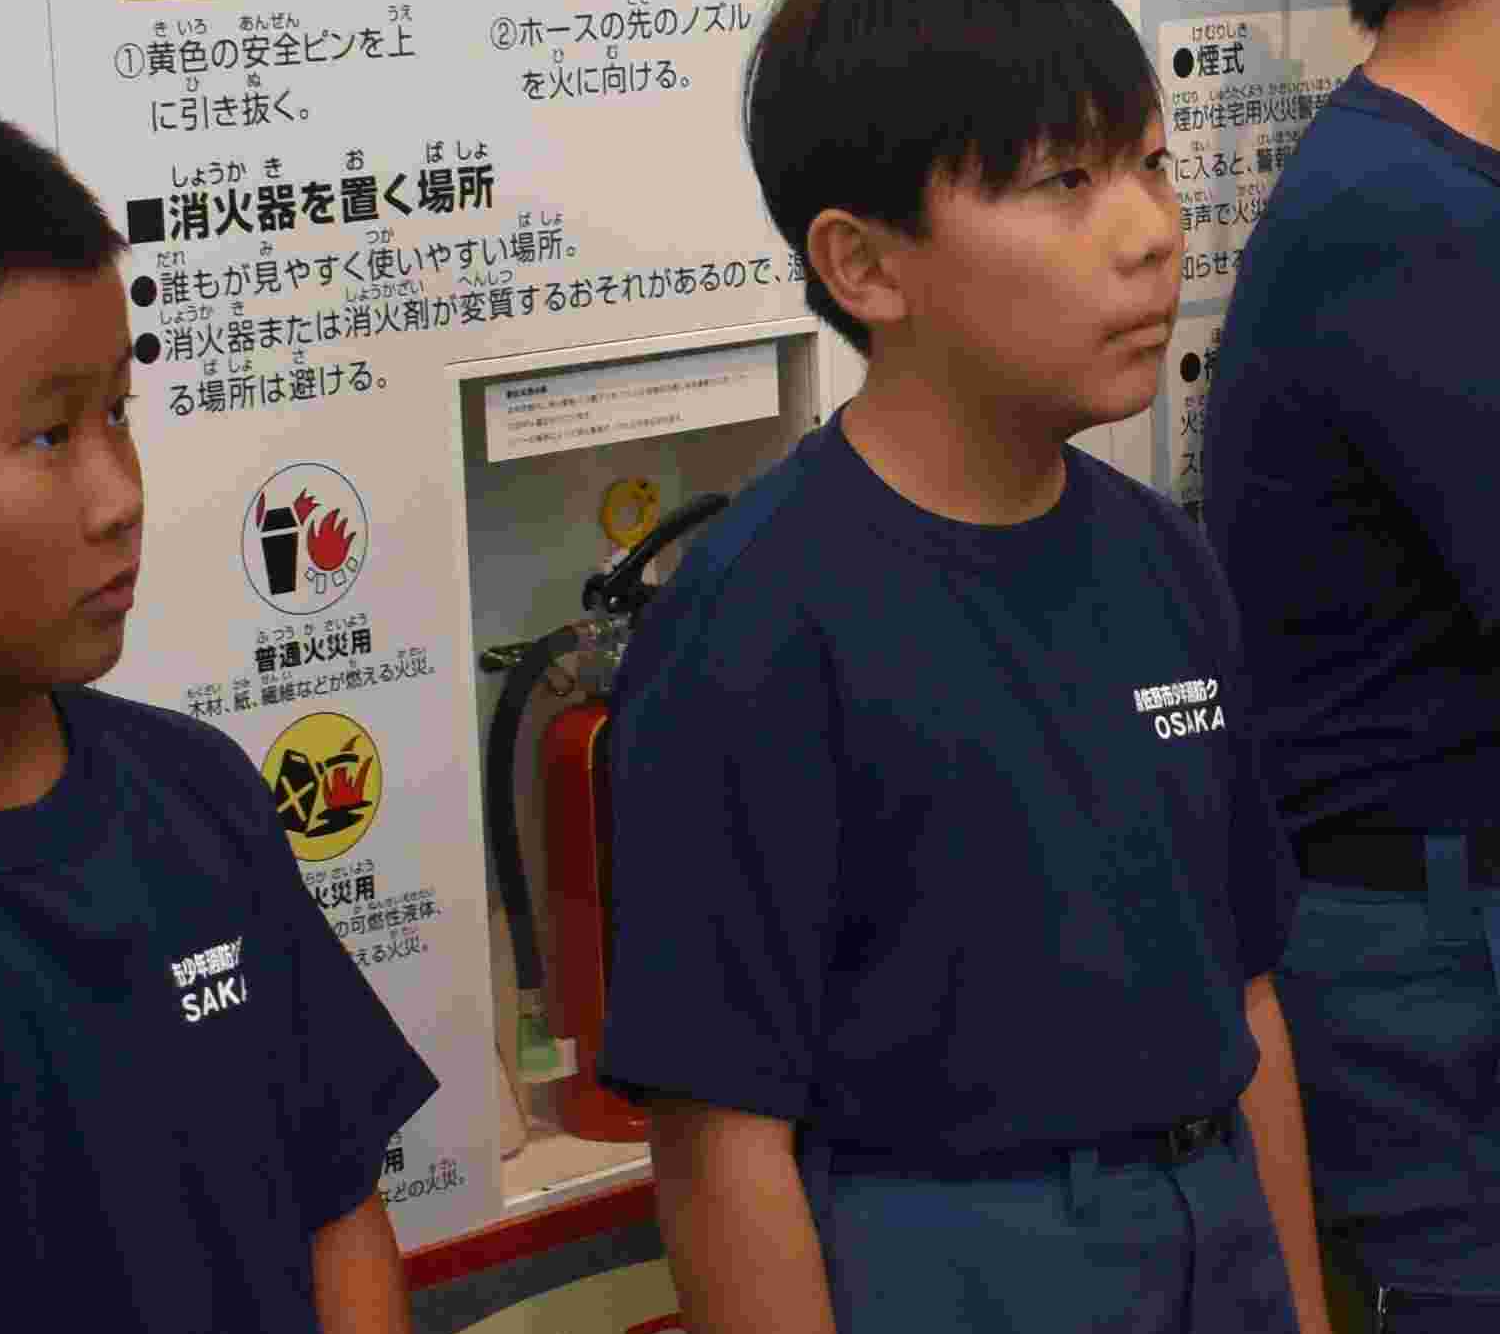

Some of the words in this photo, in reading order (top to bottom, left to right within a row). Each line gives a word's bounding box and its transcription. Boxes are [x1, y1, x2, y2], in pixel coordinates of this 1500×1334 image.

[239, 12, 299, 33] あんぜん
[387, 4, 413, 23] うえ
[490, 2, 752, 53] ②ホースの先のノズル
[113, 24, 416, 80] ①黄色の安全ピンを上
[1197, 42, 1244, 77] 煙式
[520, 60, 692, 99] を火に向ける。
[150, 85, 311, 132] に引き抜く。
[170, 162, 496, 241] 消火器を置く場所
[157, 251, 186, 268] だれ
[365, 228, 395, 246] つか
[160, 227, 578, 305] 誰もが見やすく使いやすい場所。
[459, 269, 514, 289] へんしつ
[169, 368, 389, 418] る場所は避ける。
[254, 628, 372, 674] 普通火災用
[1154, 705, 1225, 739] OSAKA
